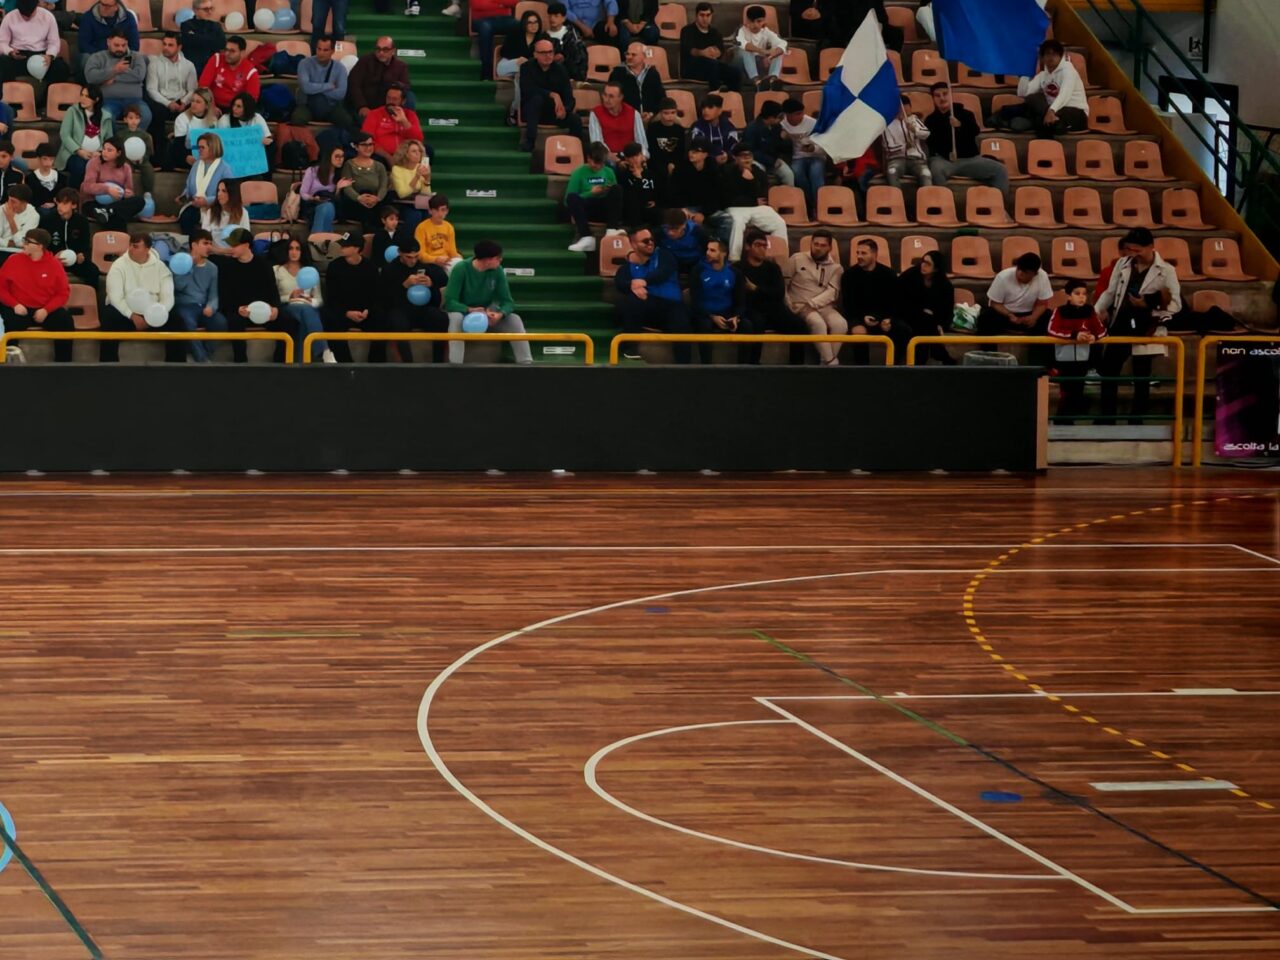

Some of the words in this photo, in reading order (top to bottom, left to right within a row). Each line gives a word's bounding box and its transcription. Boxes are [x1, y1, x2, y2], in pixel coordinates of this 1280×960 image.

[641, 178, 655, 189] 21
[1222, 347, 1246, 355] non
[1223, 443, 1265, 451] ascolta
